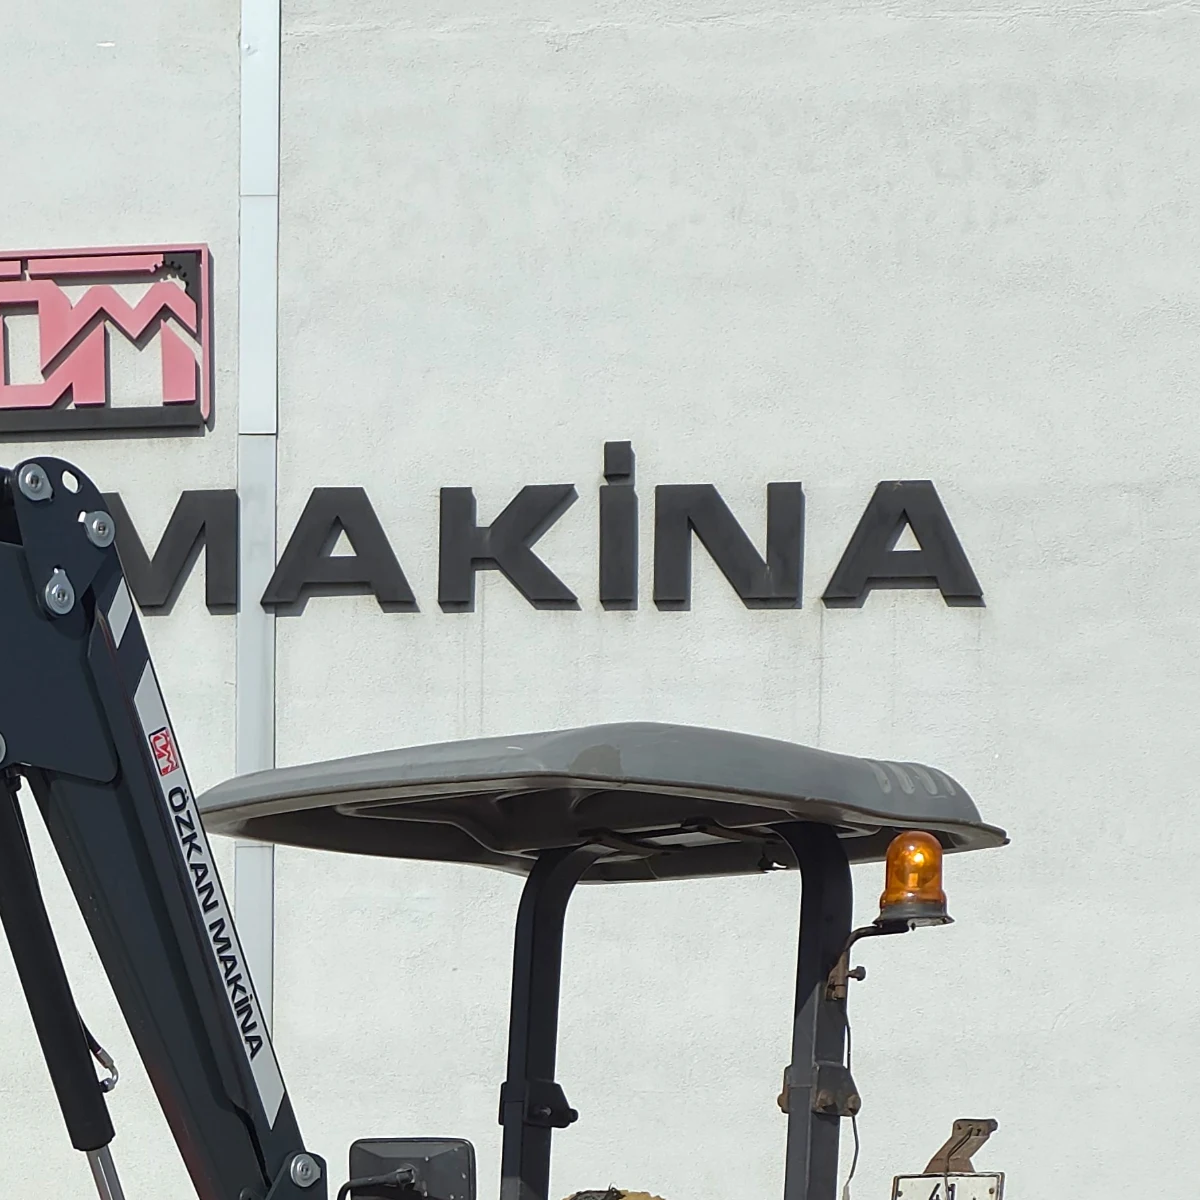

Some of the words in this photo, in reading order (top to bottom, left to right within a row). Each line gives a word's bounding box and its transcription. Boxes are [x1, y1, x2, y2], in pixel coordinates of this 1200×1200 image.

[101, 441, 983, 607] MAKİNA
[168, 786, 219, 914] ÖZKAN
[209, 918, 263, 1062] MAKİNA
